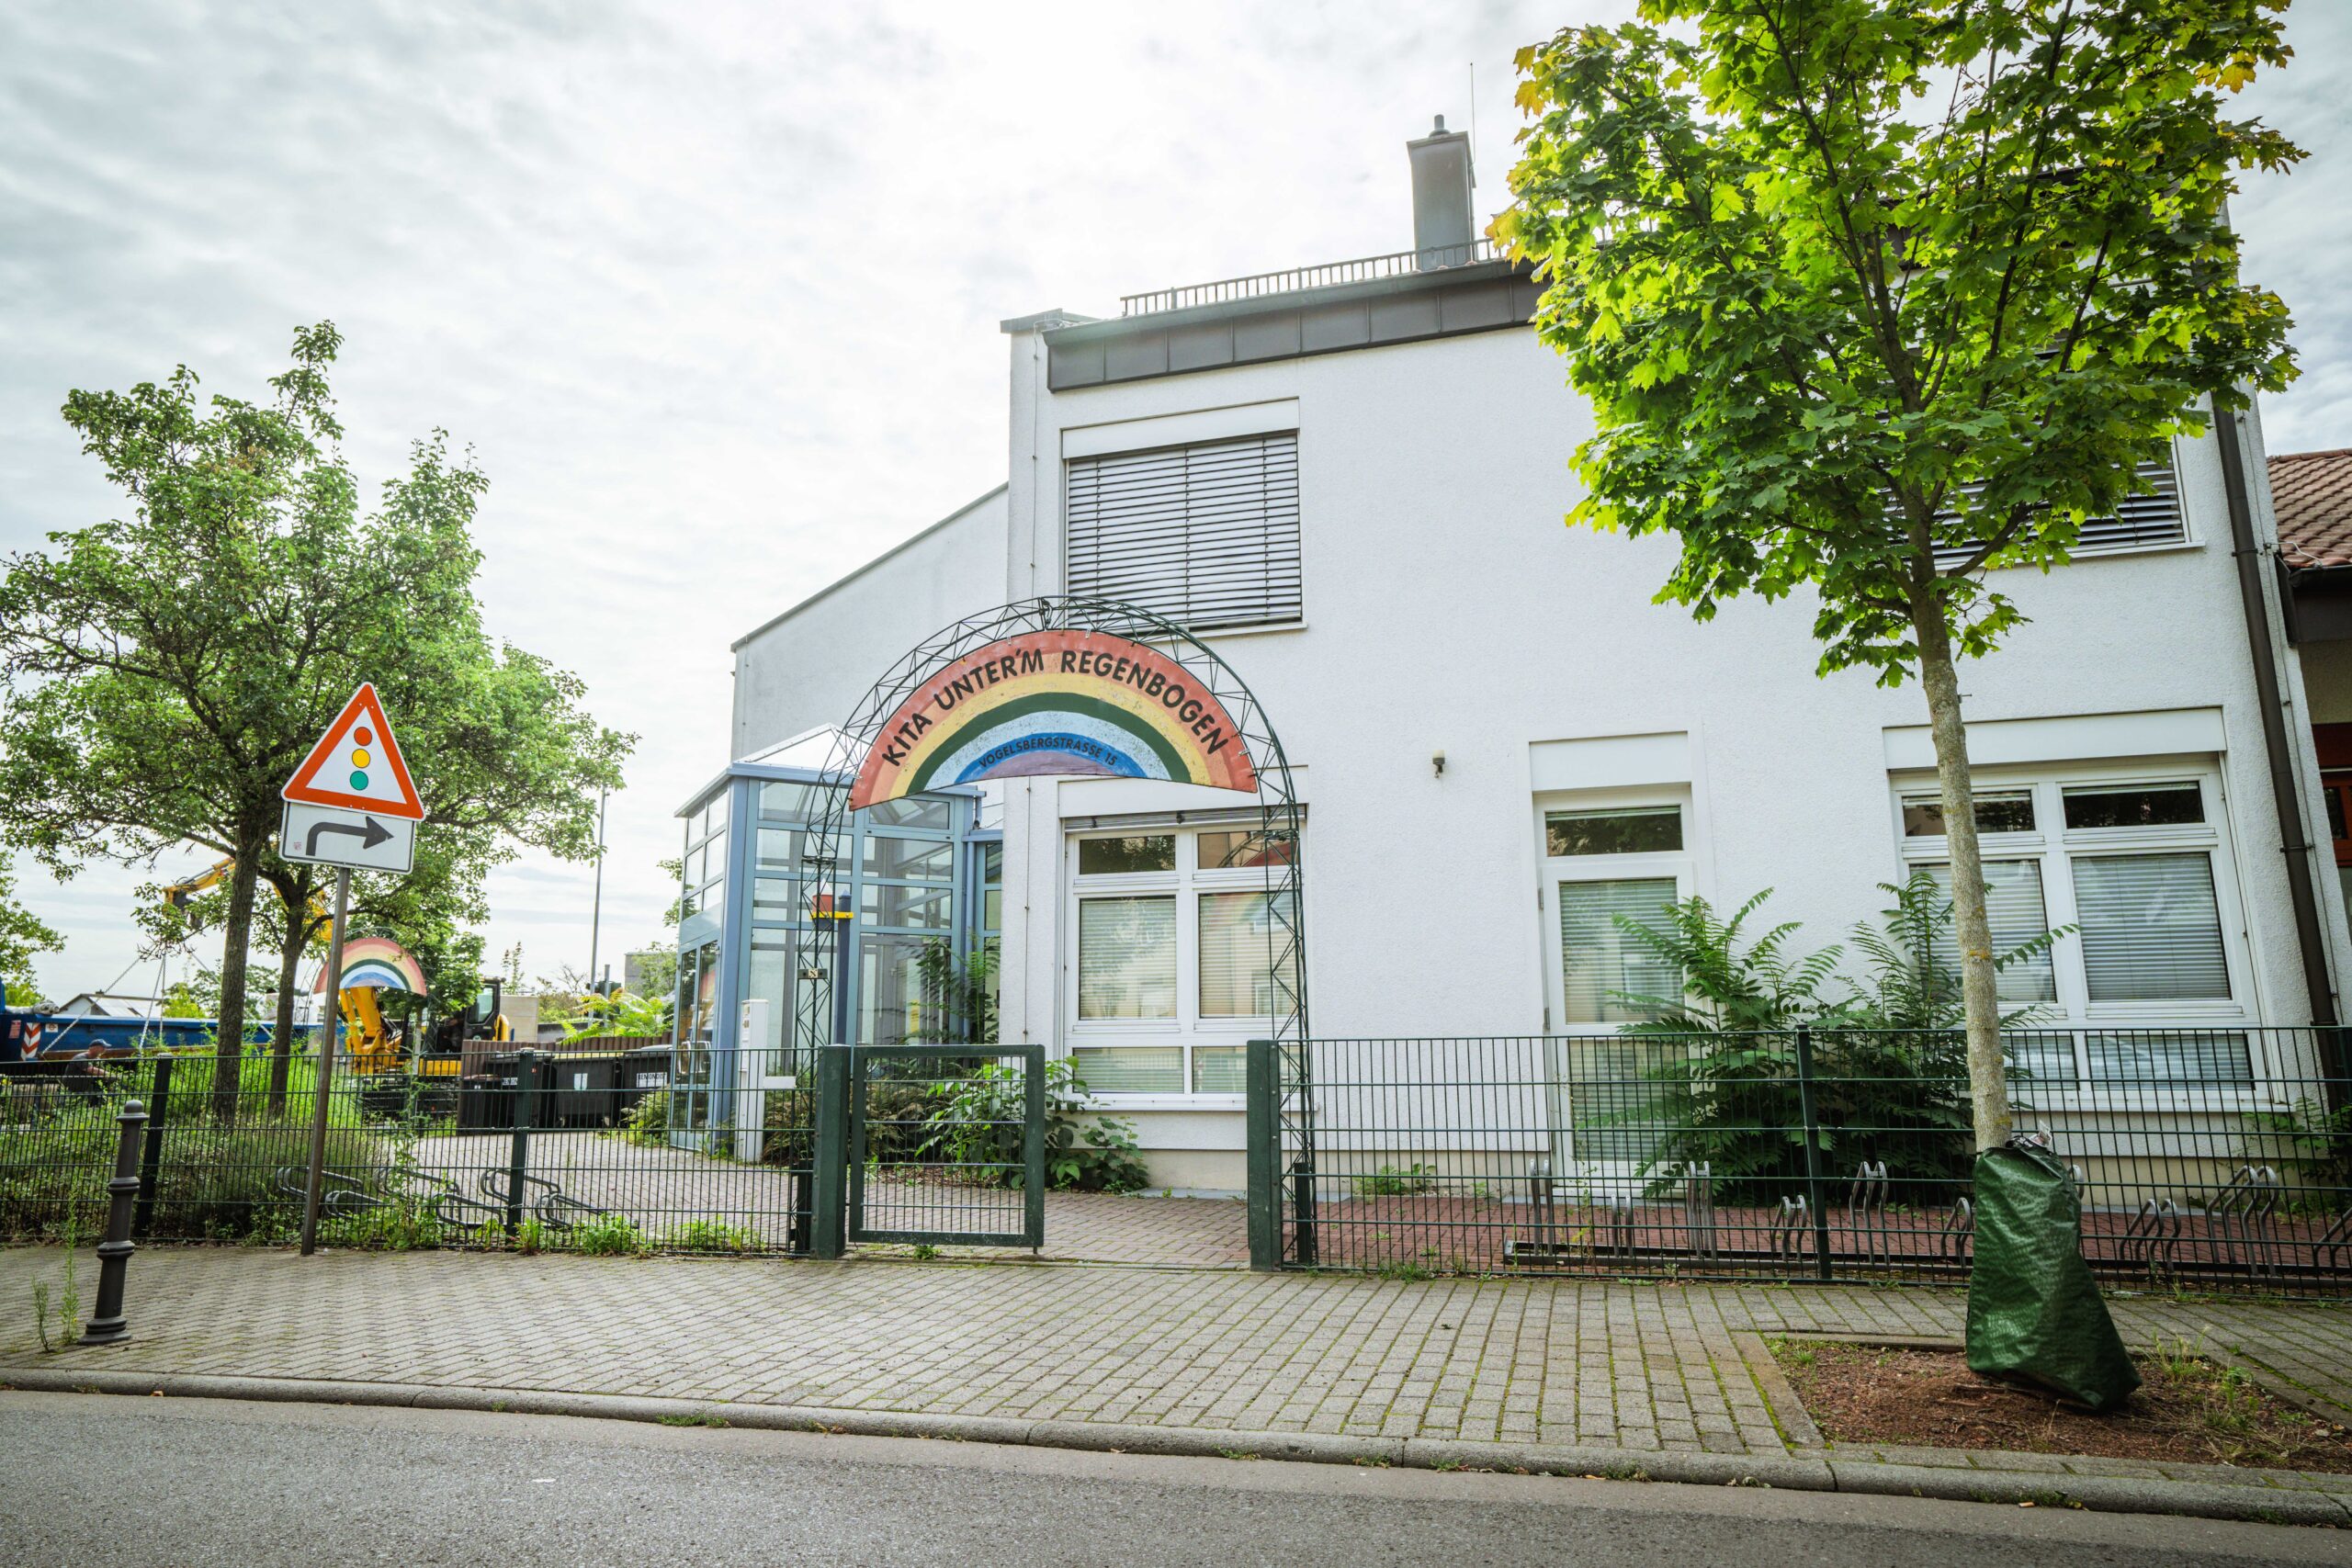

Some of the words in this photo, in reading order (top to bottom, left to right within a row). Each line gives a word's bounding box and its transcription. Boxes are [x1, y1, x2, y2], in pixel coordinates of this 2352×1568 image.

[881, 712, 933, 767] KITA
[933, 649, 1044, 710] UNTER'M
[1060, 649, 1229, 755] REGENBOGEN
[978, 737, 1103, 768] VOGELSBERGSTRASSE
[1104, 751, 1118, 766] 15
